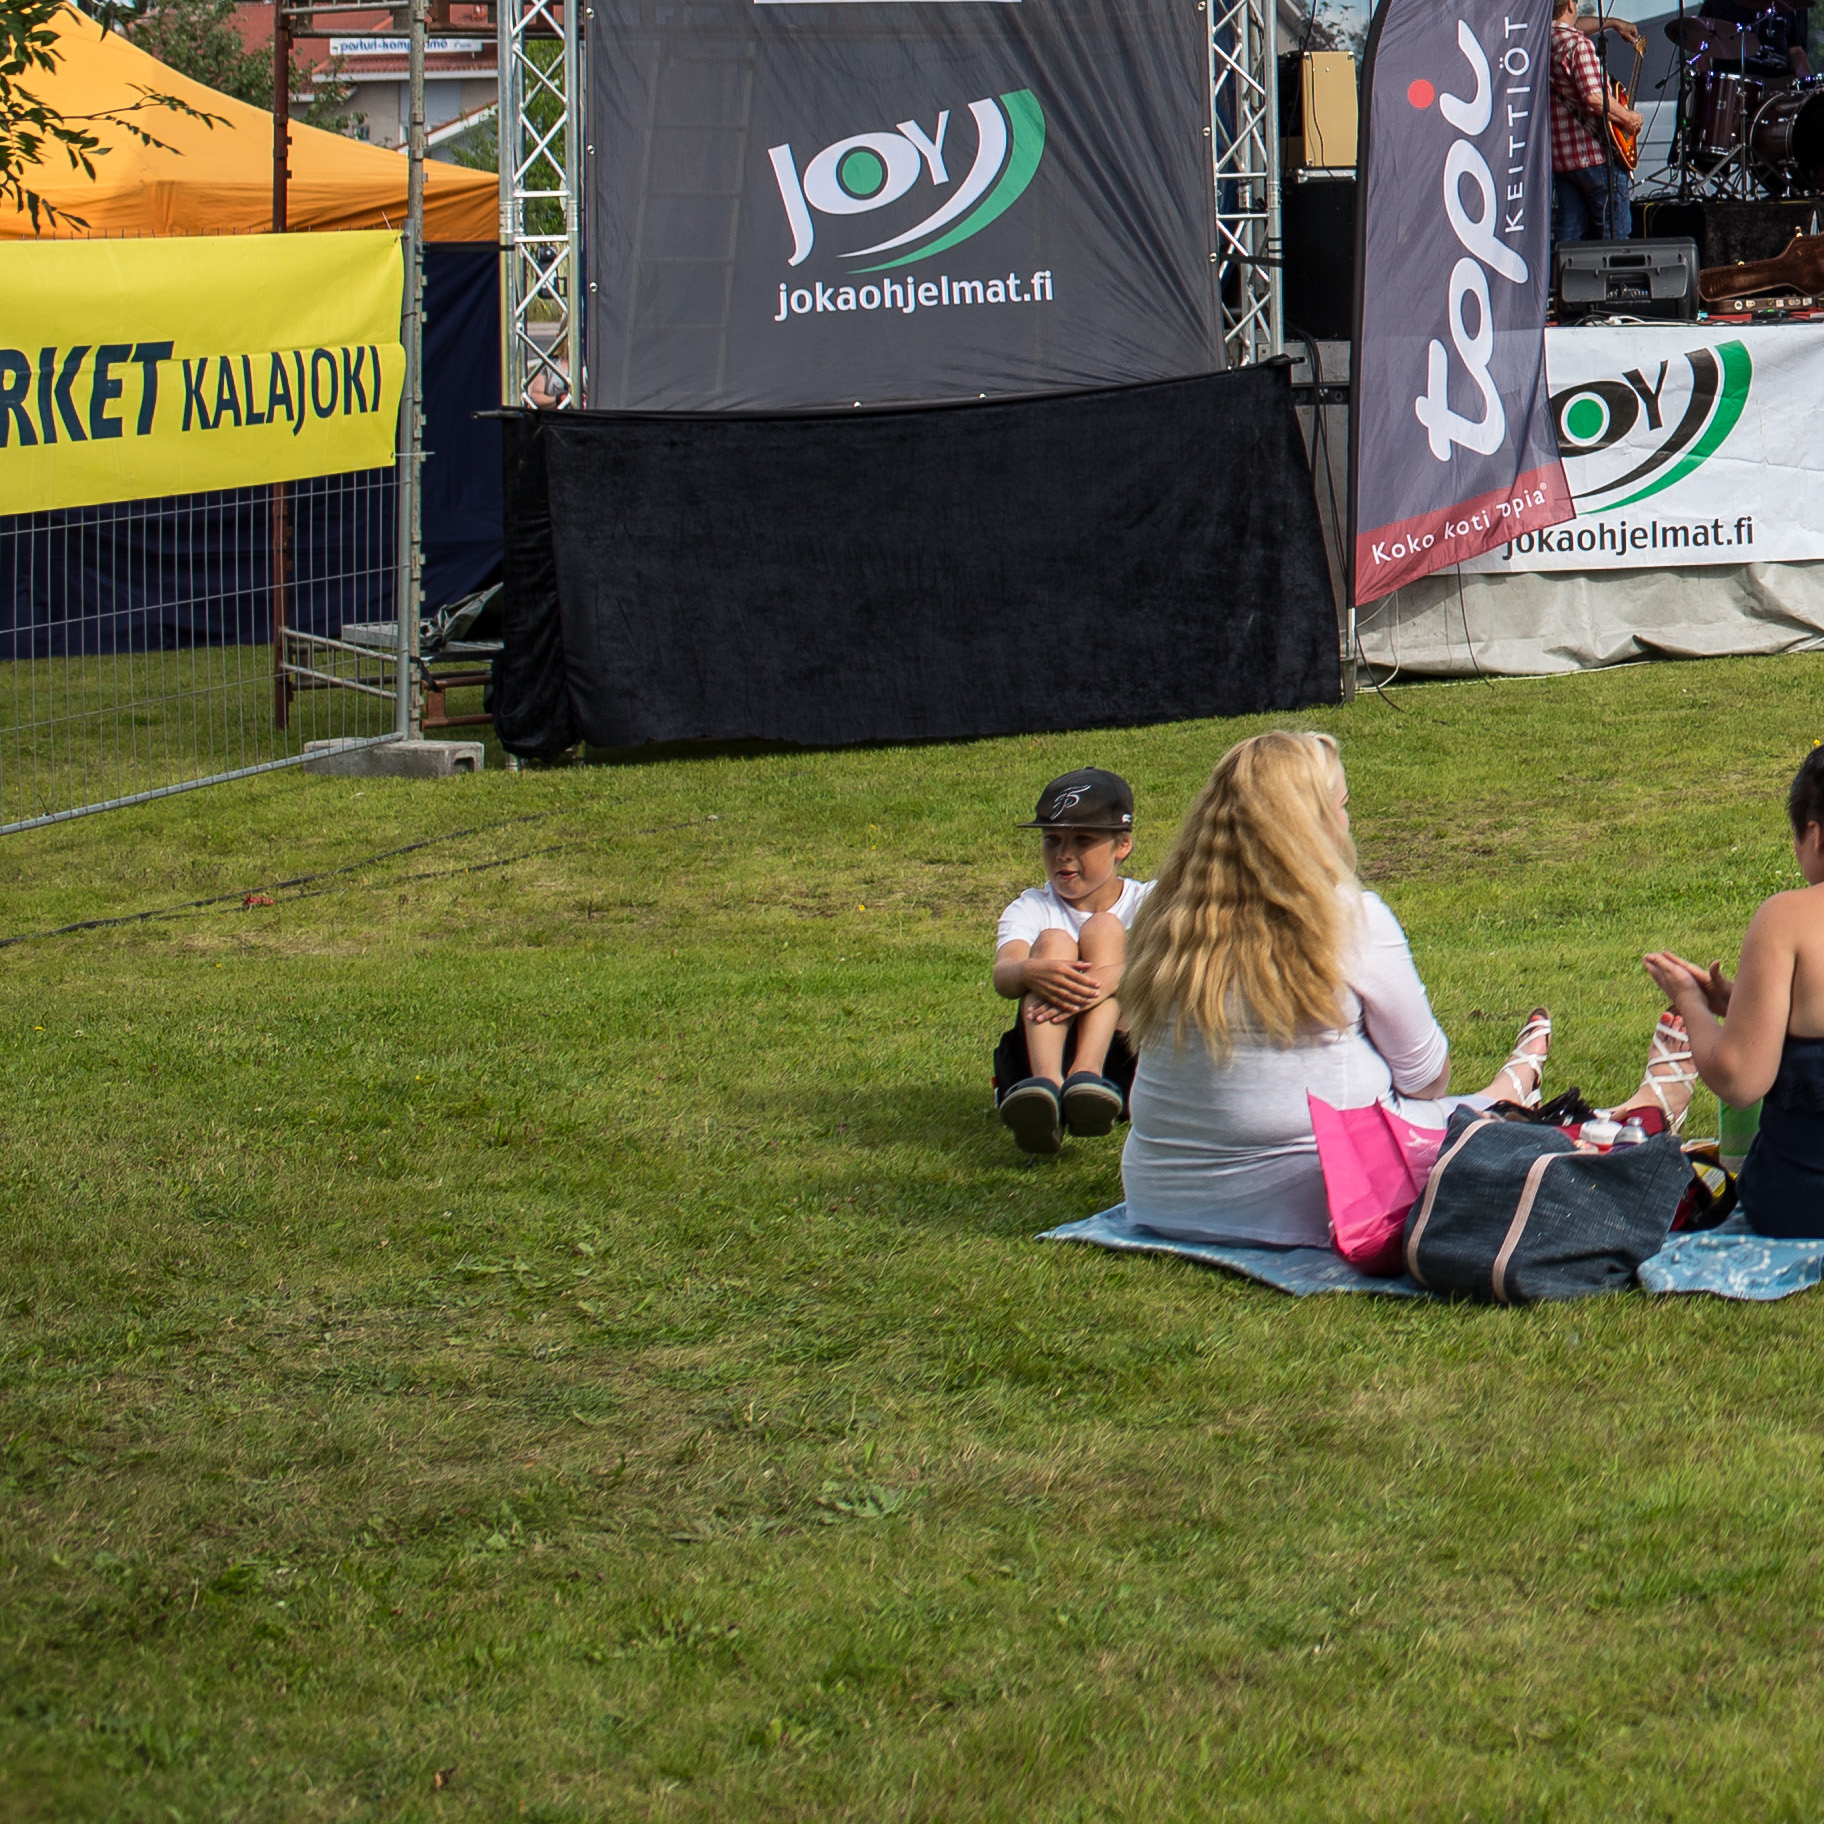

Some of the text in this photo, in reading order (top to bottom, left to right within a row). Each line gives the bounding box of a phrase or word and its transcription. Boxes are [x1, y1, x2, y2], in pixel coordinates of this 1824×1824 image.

[1499, 16, 1531, 234] KEITTIÖT
[767, 109, 950, 267] JOY
[774, 270, 1054, 322] jokaohjelmat.fi
[182, 345, 382, 437] KALAJOKI
[1371, 534, 1435, 565] Koko
[1444, 509, 1491, 540] koti
[1502, 516, 1754, 561] jokaohjelmat.fi
